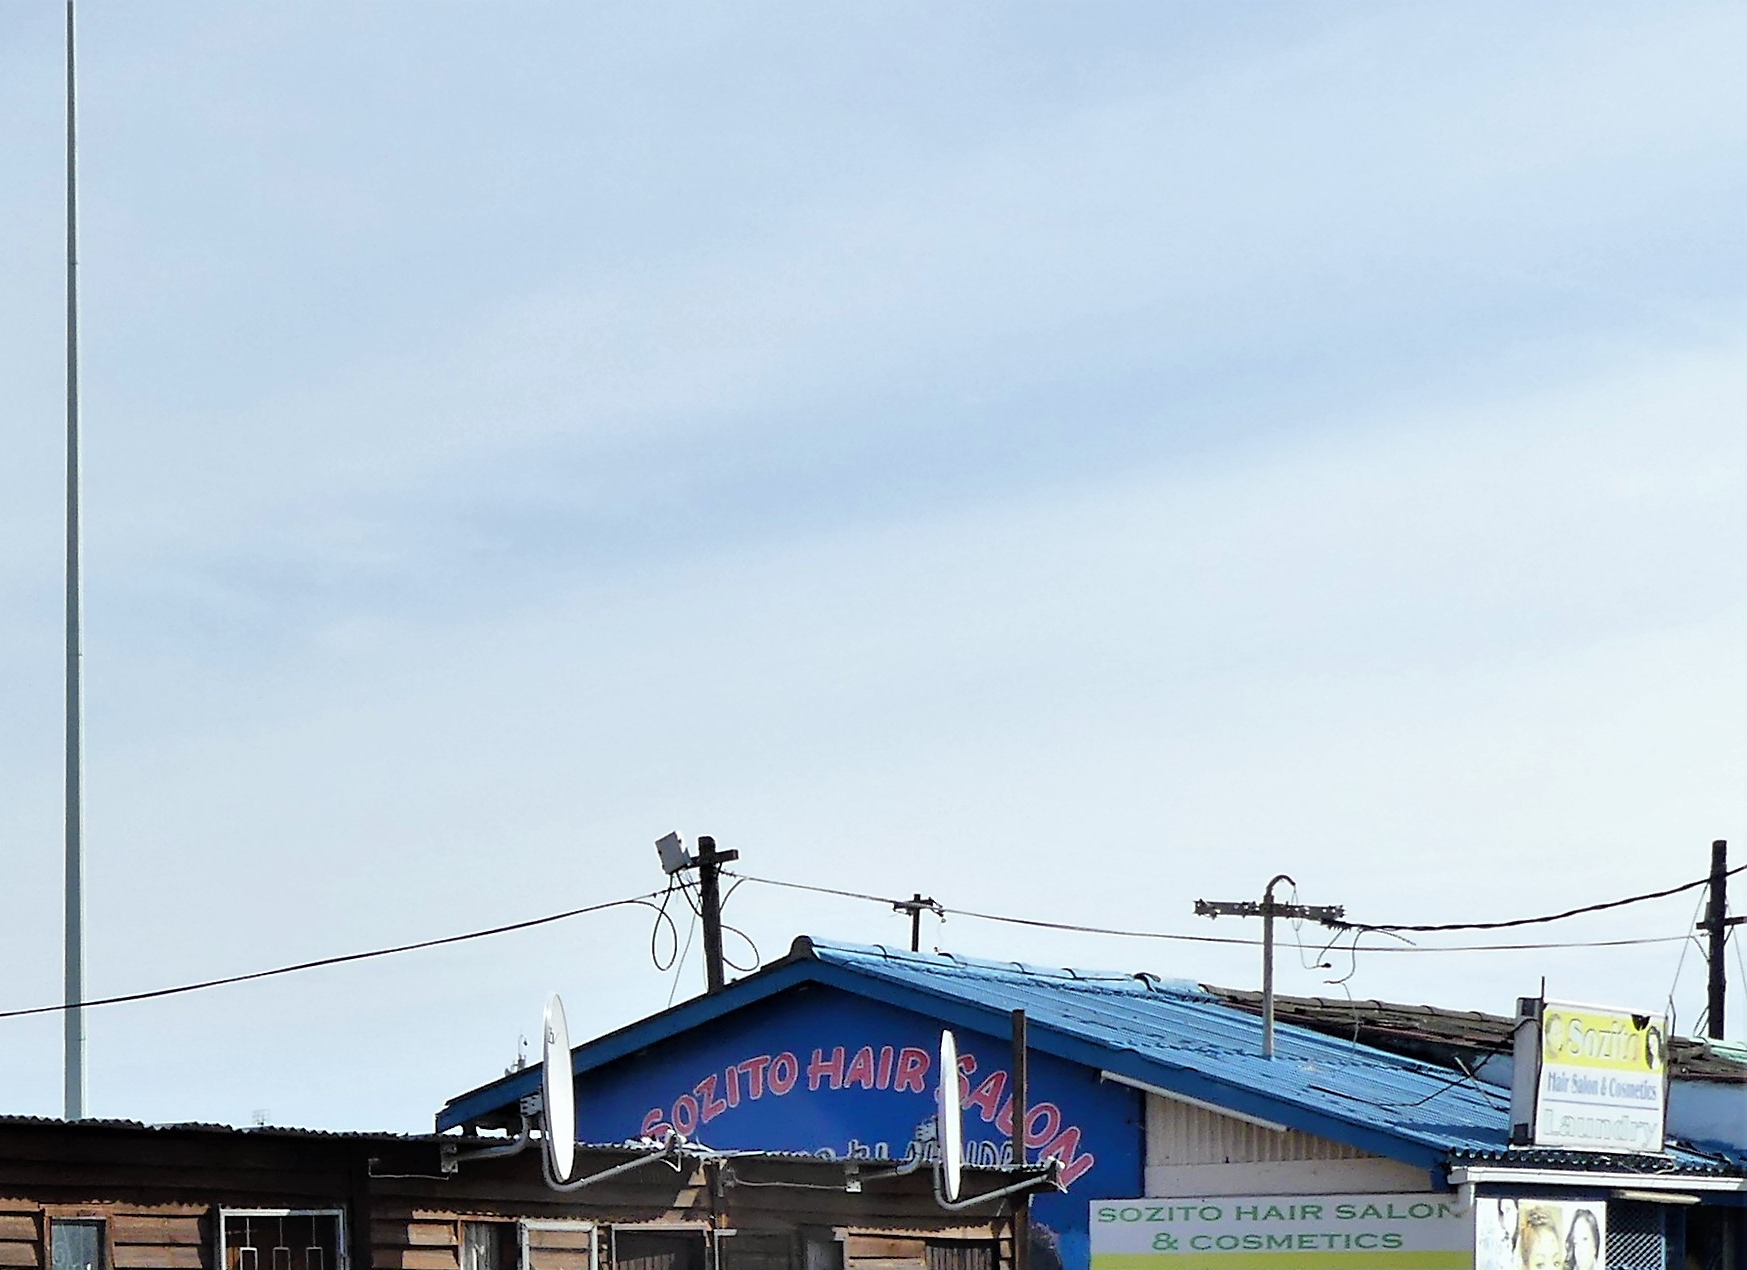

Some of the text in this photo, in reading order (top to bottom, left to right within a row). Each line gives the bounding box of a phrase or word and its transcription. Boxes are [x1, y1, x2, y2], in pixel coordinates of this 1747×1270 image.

[640, 1051, 799, 1140] SOZITO
[807, 1046, 931, 1093] HAIR
[1547, 1071, 1570, 1093] Hair
[1572, 1073, 1599, 1096] Salon
[1609, 1077, 1658, 1101] Cosmetics
[1543, 1108, 1658, 1149] Laundry
[1098, 1202, 1462, 1222] SOZITO HAIR SALON
[1153, 1232, 1404, 1250] & COSMETICS
